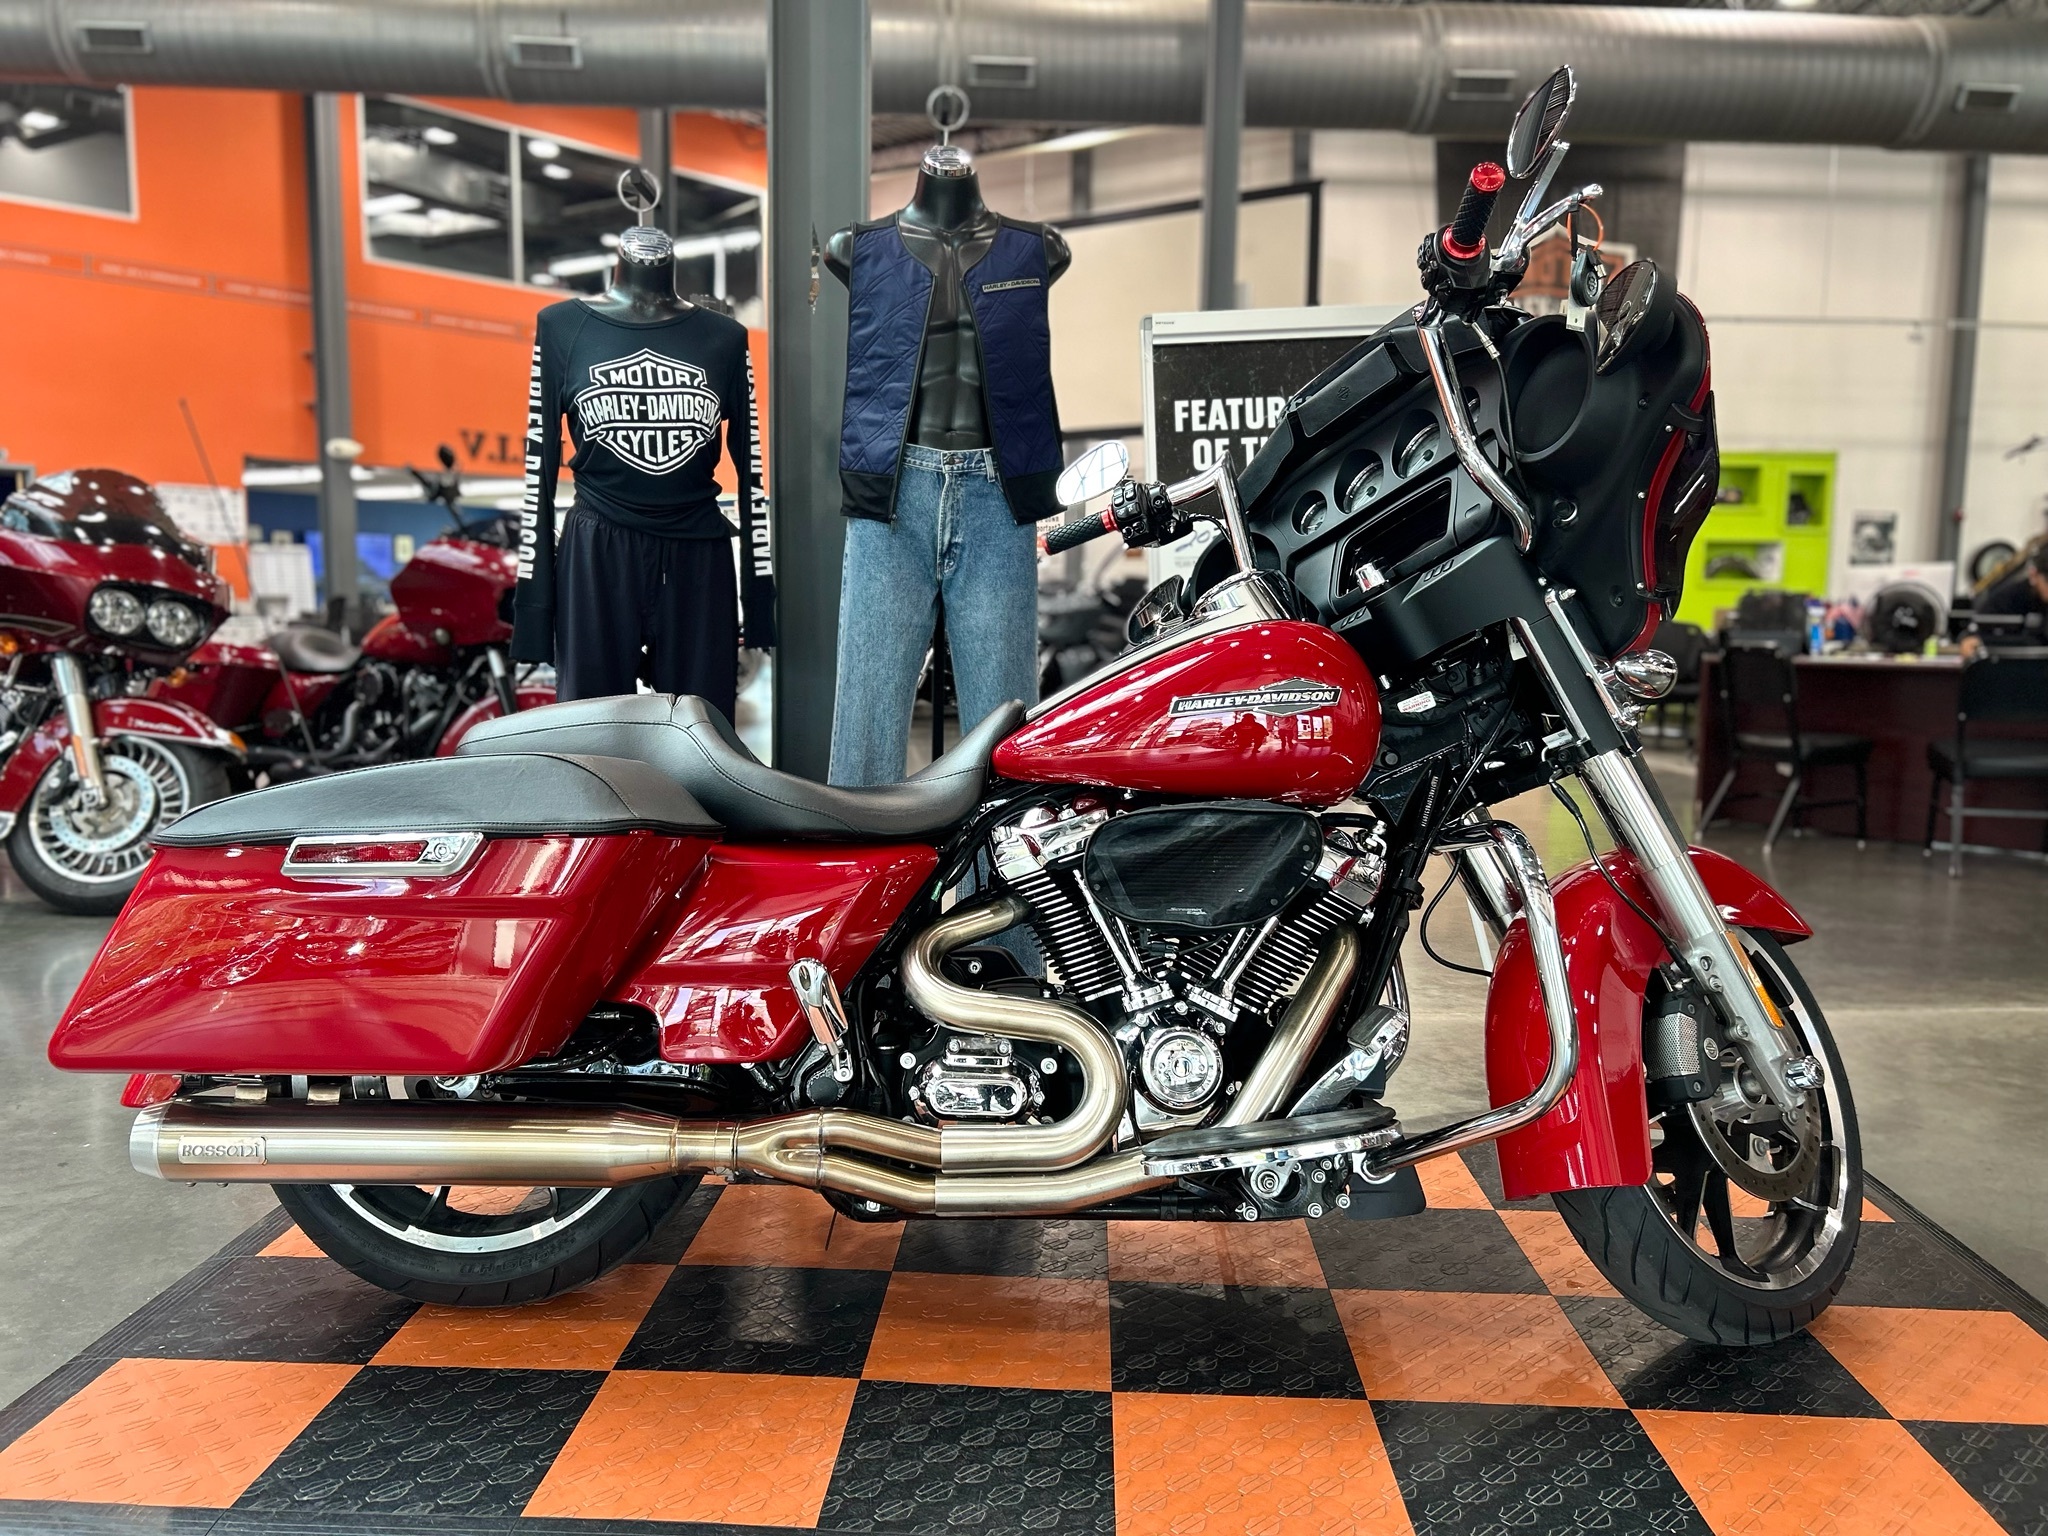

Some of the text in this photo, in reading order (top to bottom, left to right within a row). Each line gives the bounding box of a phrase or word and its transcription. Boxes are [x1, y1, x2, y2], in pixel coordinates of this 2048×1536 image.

[984, 279, 1040, 291] HARLEY-DAVIDSON
[609, 360, 691, 386] MOTOR
[583, 394, 719, 427] HARLEY-DAVIDSON
[1173, 396, 1294, 432] FEATUR
[616, 430, 693, 463] CYCLES
[1178, 690, 1335, 712] HARLEY-DAVIDSON
